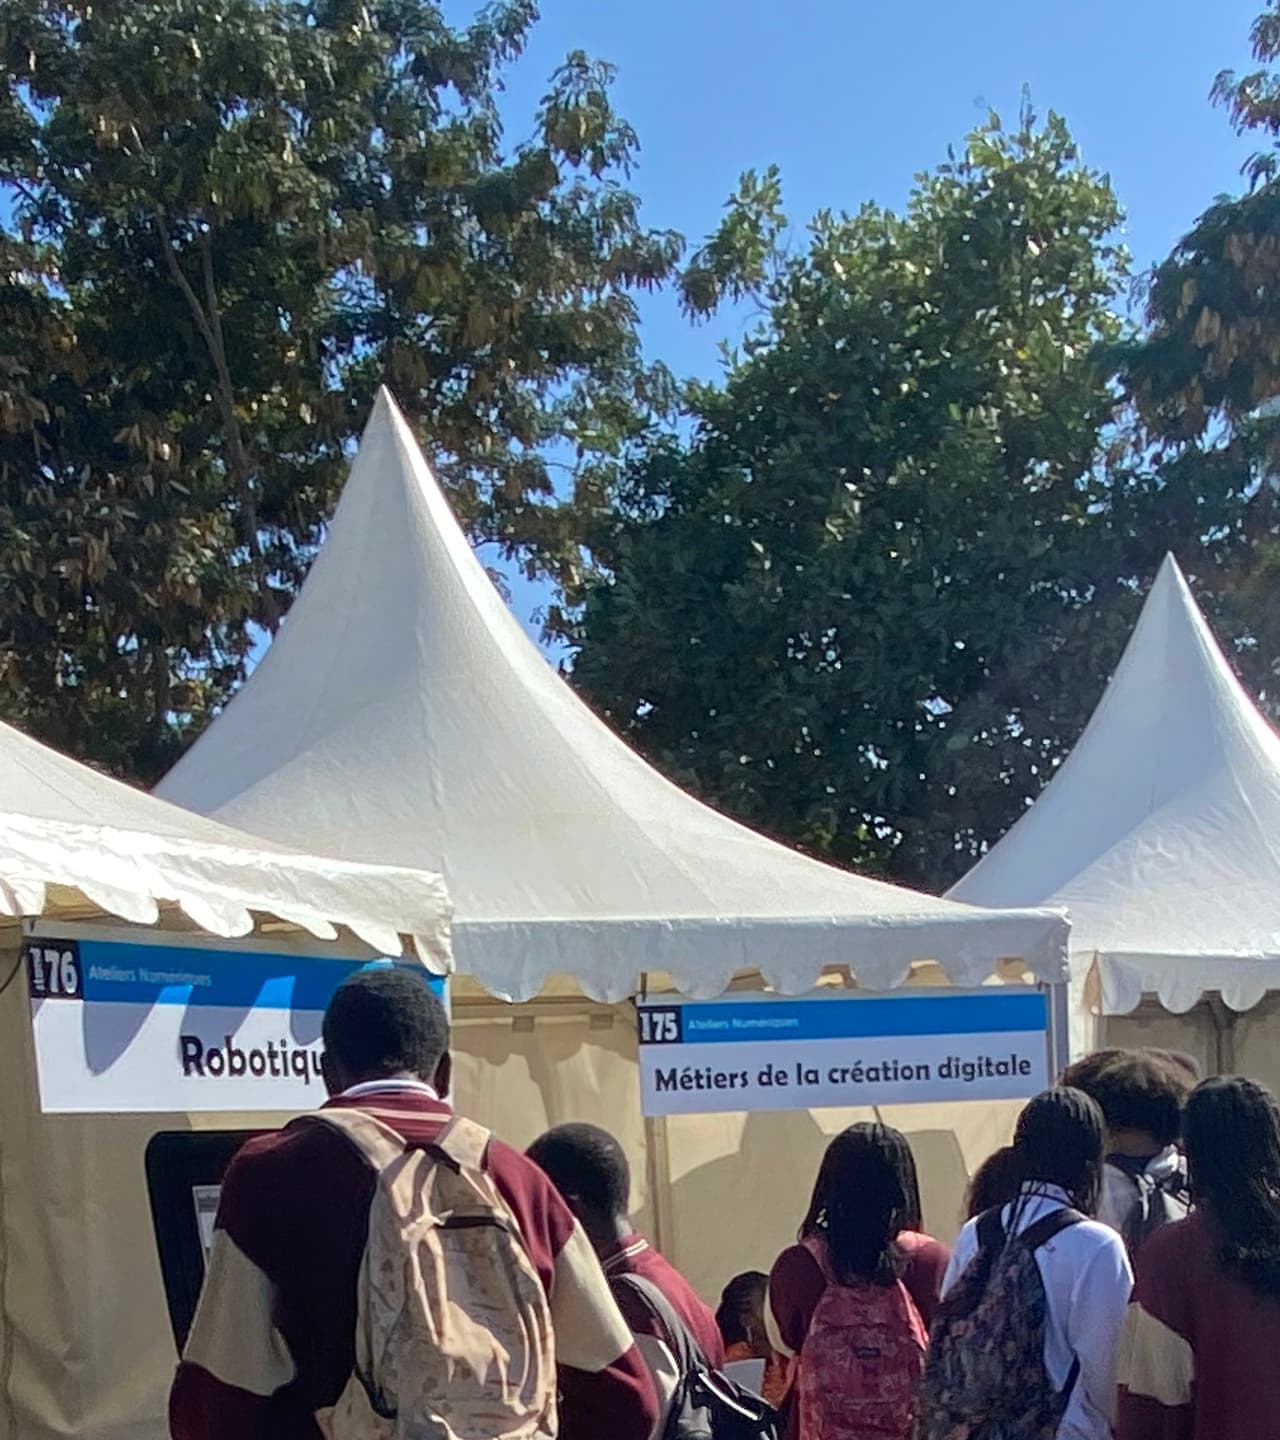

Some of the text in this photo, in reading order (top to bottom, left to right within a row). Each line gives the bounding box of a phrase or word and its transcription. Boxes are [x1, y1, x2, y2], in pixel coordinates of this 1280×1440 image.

[30, 947, 78, 994] 176
[639, 1012, 678, 1041] 175
[654, 1054, 1032, 1092] Métiers de la création digitale
